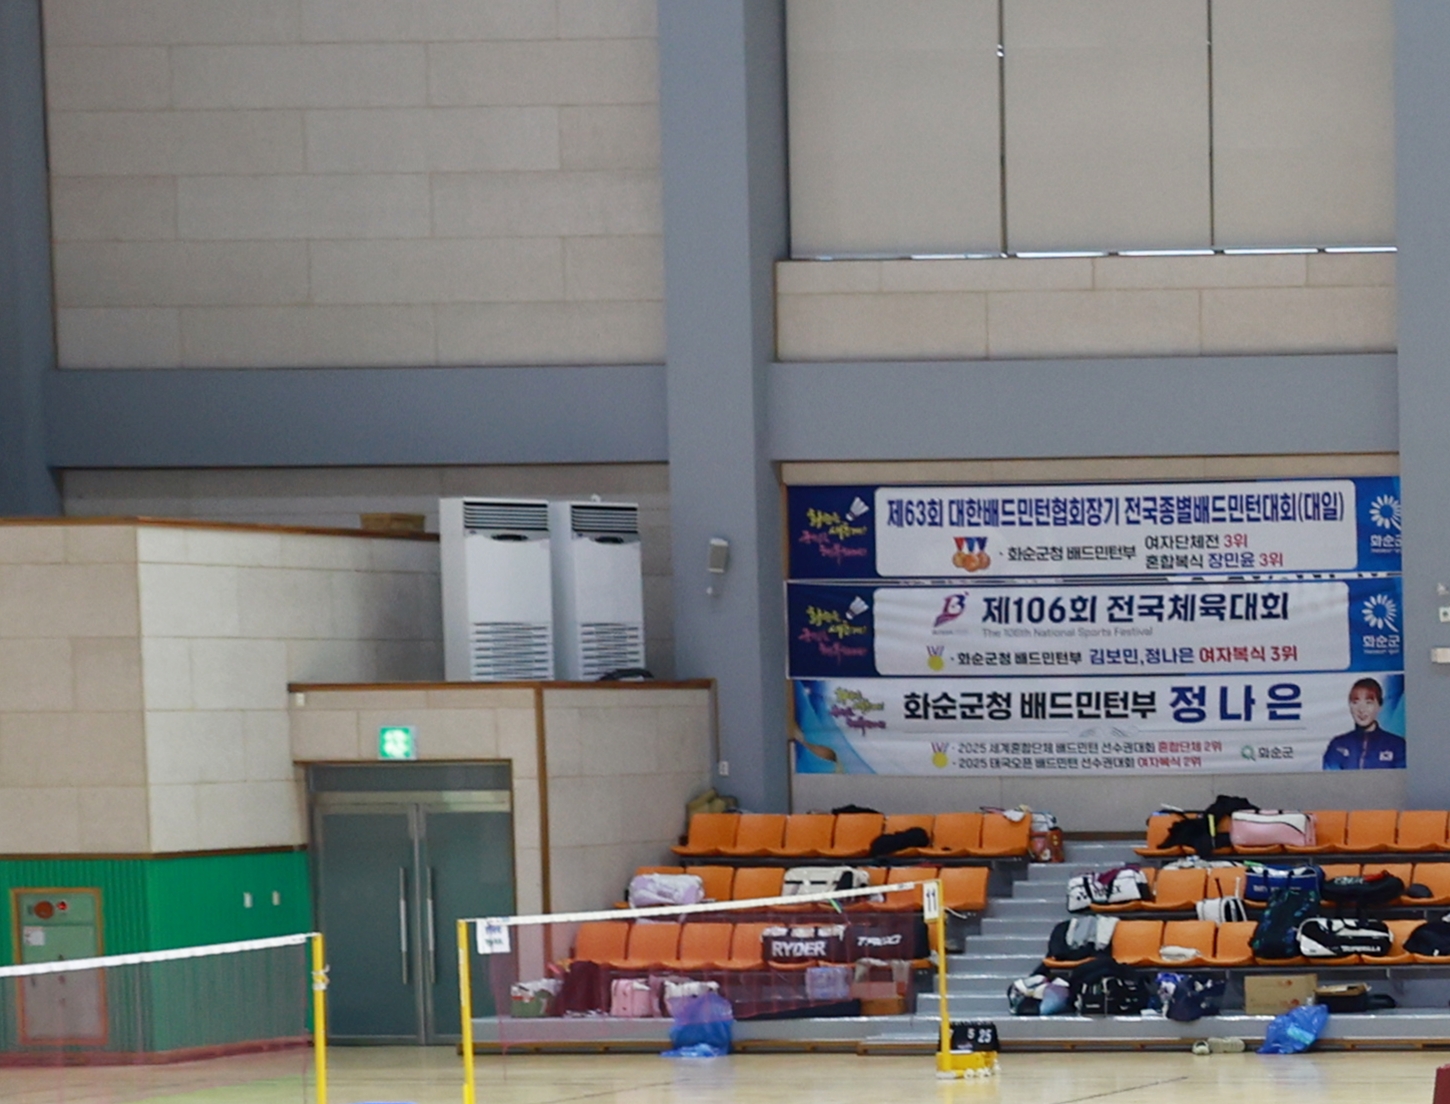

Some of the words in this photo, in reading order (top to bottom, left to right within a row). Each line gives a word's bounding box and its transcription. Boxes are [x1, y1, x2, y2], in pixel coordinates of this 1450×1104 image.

[887, 499, 944, 527] 제63회
[949, 496, 1119, 527] 대한배드민턴협회장기
[1124, 491, 1345, 525] 전국종별배드민턴대회(대일)
[1145, 534, 1219, 550] 여자단체전
[1223, 533, 1248, 549] 3위
[1007, 545, 1061, 561] 화순군청
[1066, 544, 1137, 561] 배드민턴부
[1145, 553, 1203, 569] 혼합복식
[1259, 553, 1284, 567] 3위
[982, 595, 1096, 624] 제106회
[1107, 592, 1289, 622] 전국체육대회
[958, 653, 1011, 666] 화순군청
[1015, 652, 1082, 665] 배드민턴부
[1090, 647, 1194, 665] 김보민,정나은
[1199, 646, 1265, 662] 여자복식
[1270, 645, 1298, 662] 3위
[903, 692, 1012, 720] 화순군청
[1020, 690, 1156, 719] 배드민턴부
[771, 941, 826, 957] RYDER
